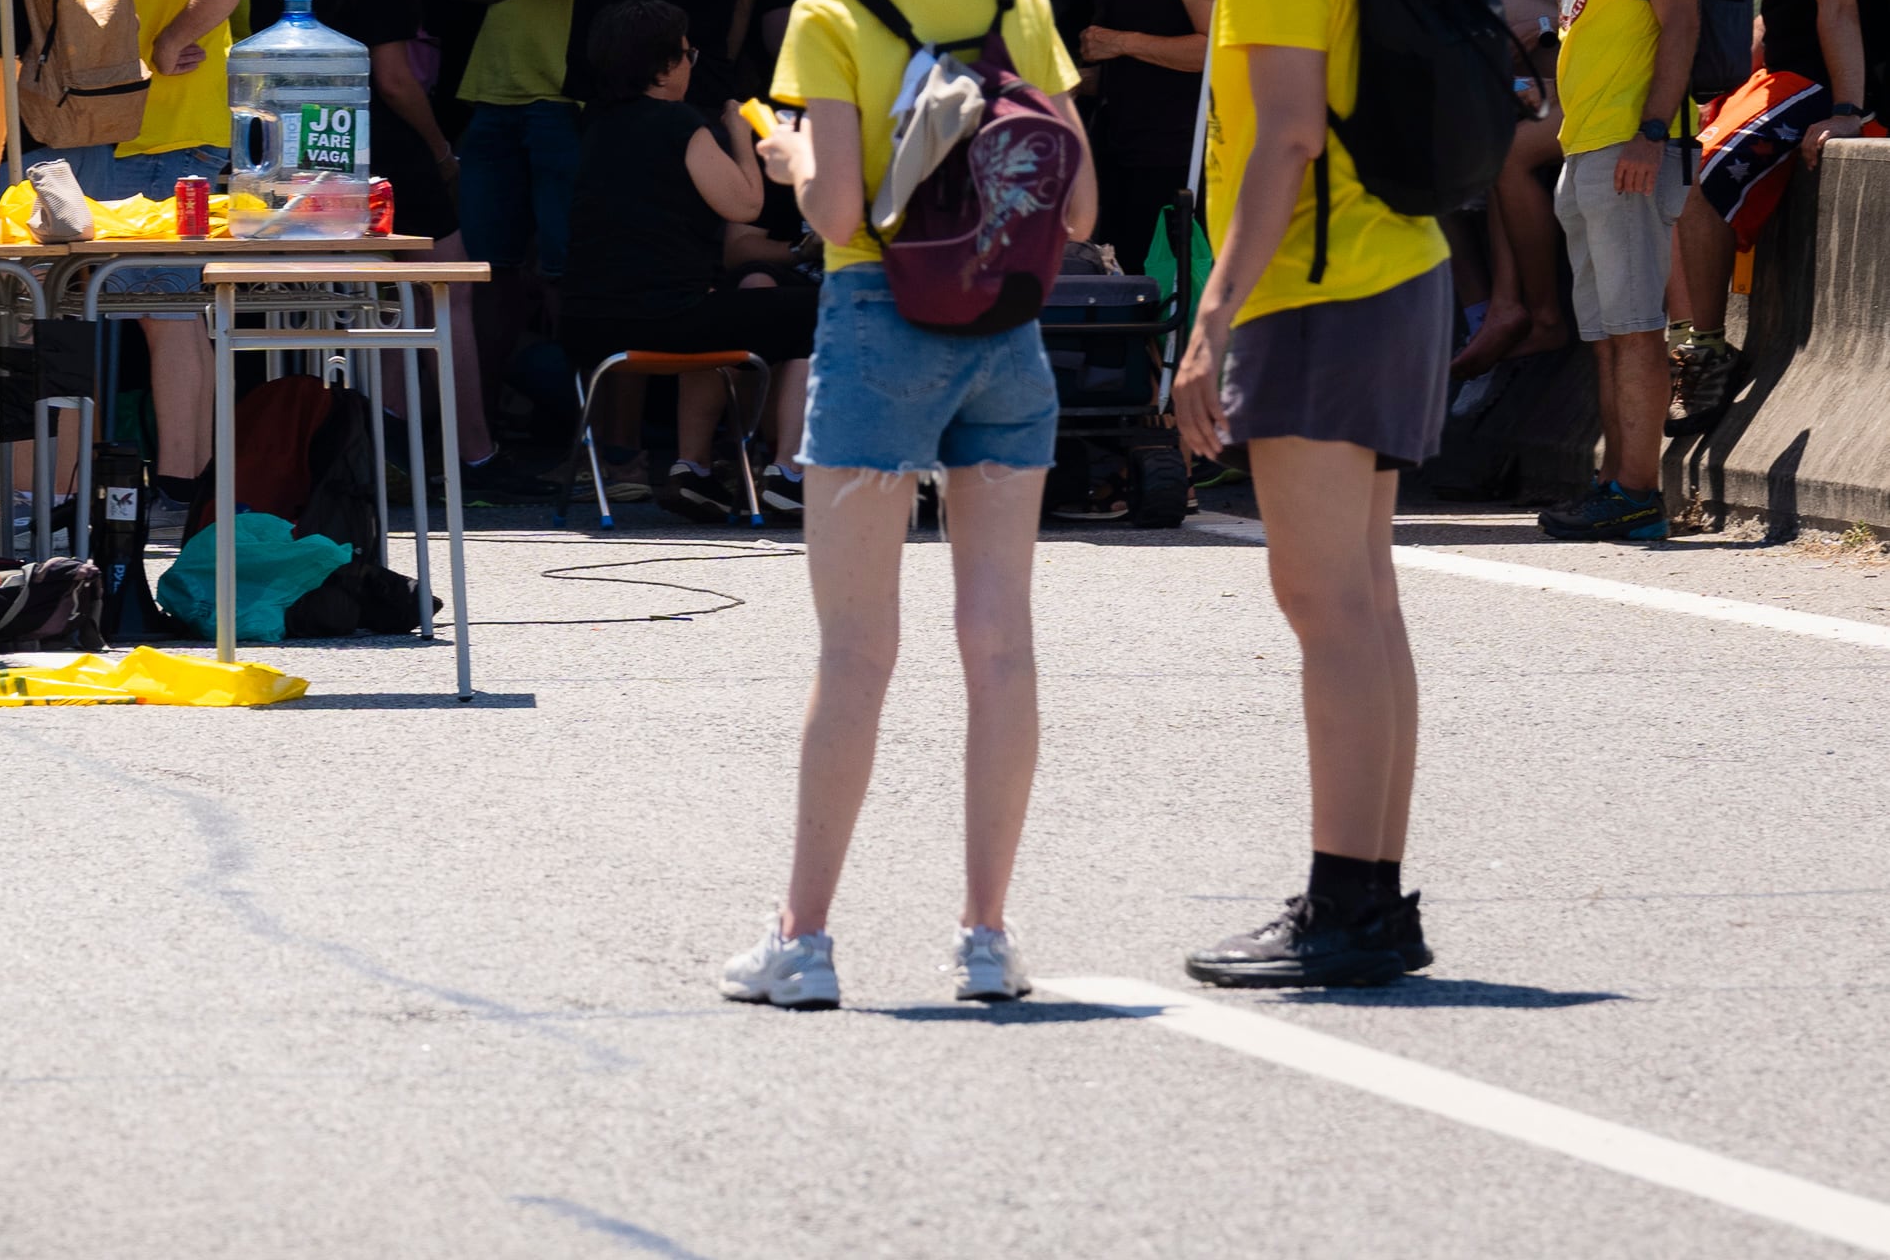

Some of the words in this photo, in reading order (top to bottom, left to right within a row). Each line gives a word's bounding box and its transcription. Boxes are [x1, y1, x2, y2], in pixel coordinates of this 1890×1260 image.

[309, 108, 351, 133] JO
[307, 132, 351, 148] FARÉ
[307, 149, 350, 163] VAGA
